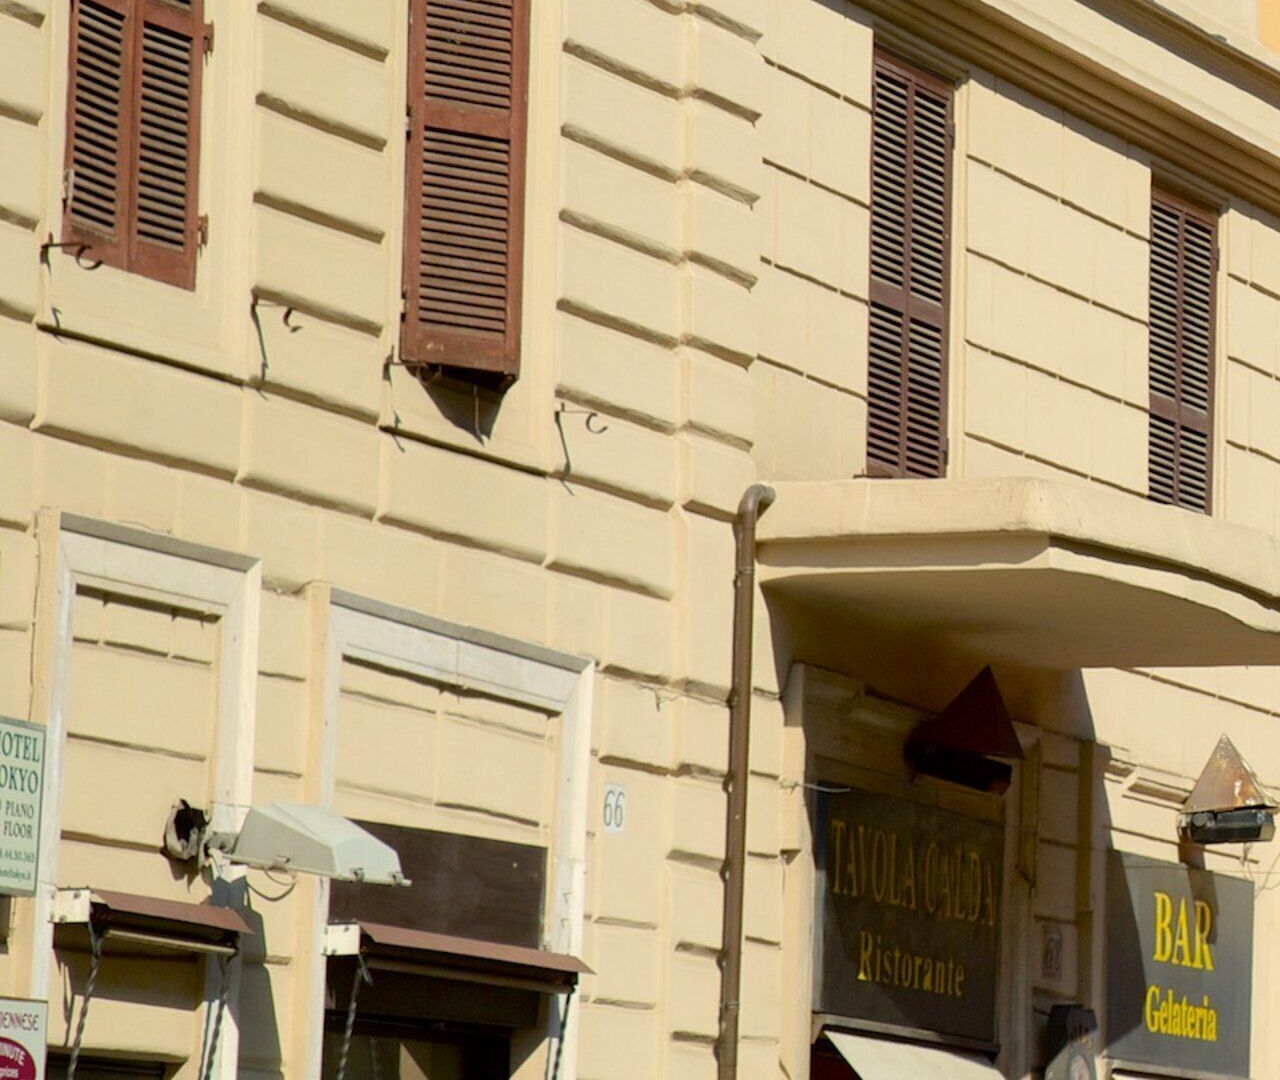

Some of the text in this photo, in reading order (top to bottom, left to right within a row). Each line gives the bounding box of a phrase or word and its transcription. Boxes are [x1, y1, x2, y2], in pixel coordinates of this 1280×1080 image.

[0, 731, 41, 763] OTEL
[0, 764, 39, 795] OKYO
[3, 821, 33, 840] FLOOR
[603, 789, 625, 828] 66
[831, 818, 996, 928] TAVOLA CALDA
[1153, 891, 1214, 971] BAR
[856, 928, 967, 999] Ristorante
[1144, 984, 1218, 1043] Gelateria
